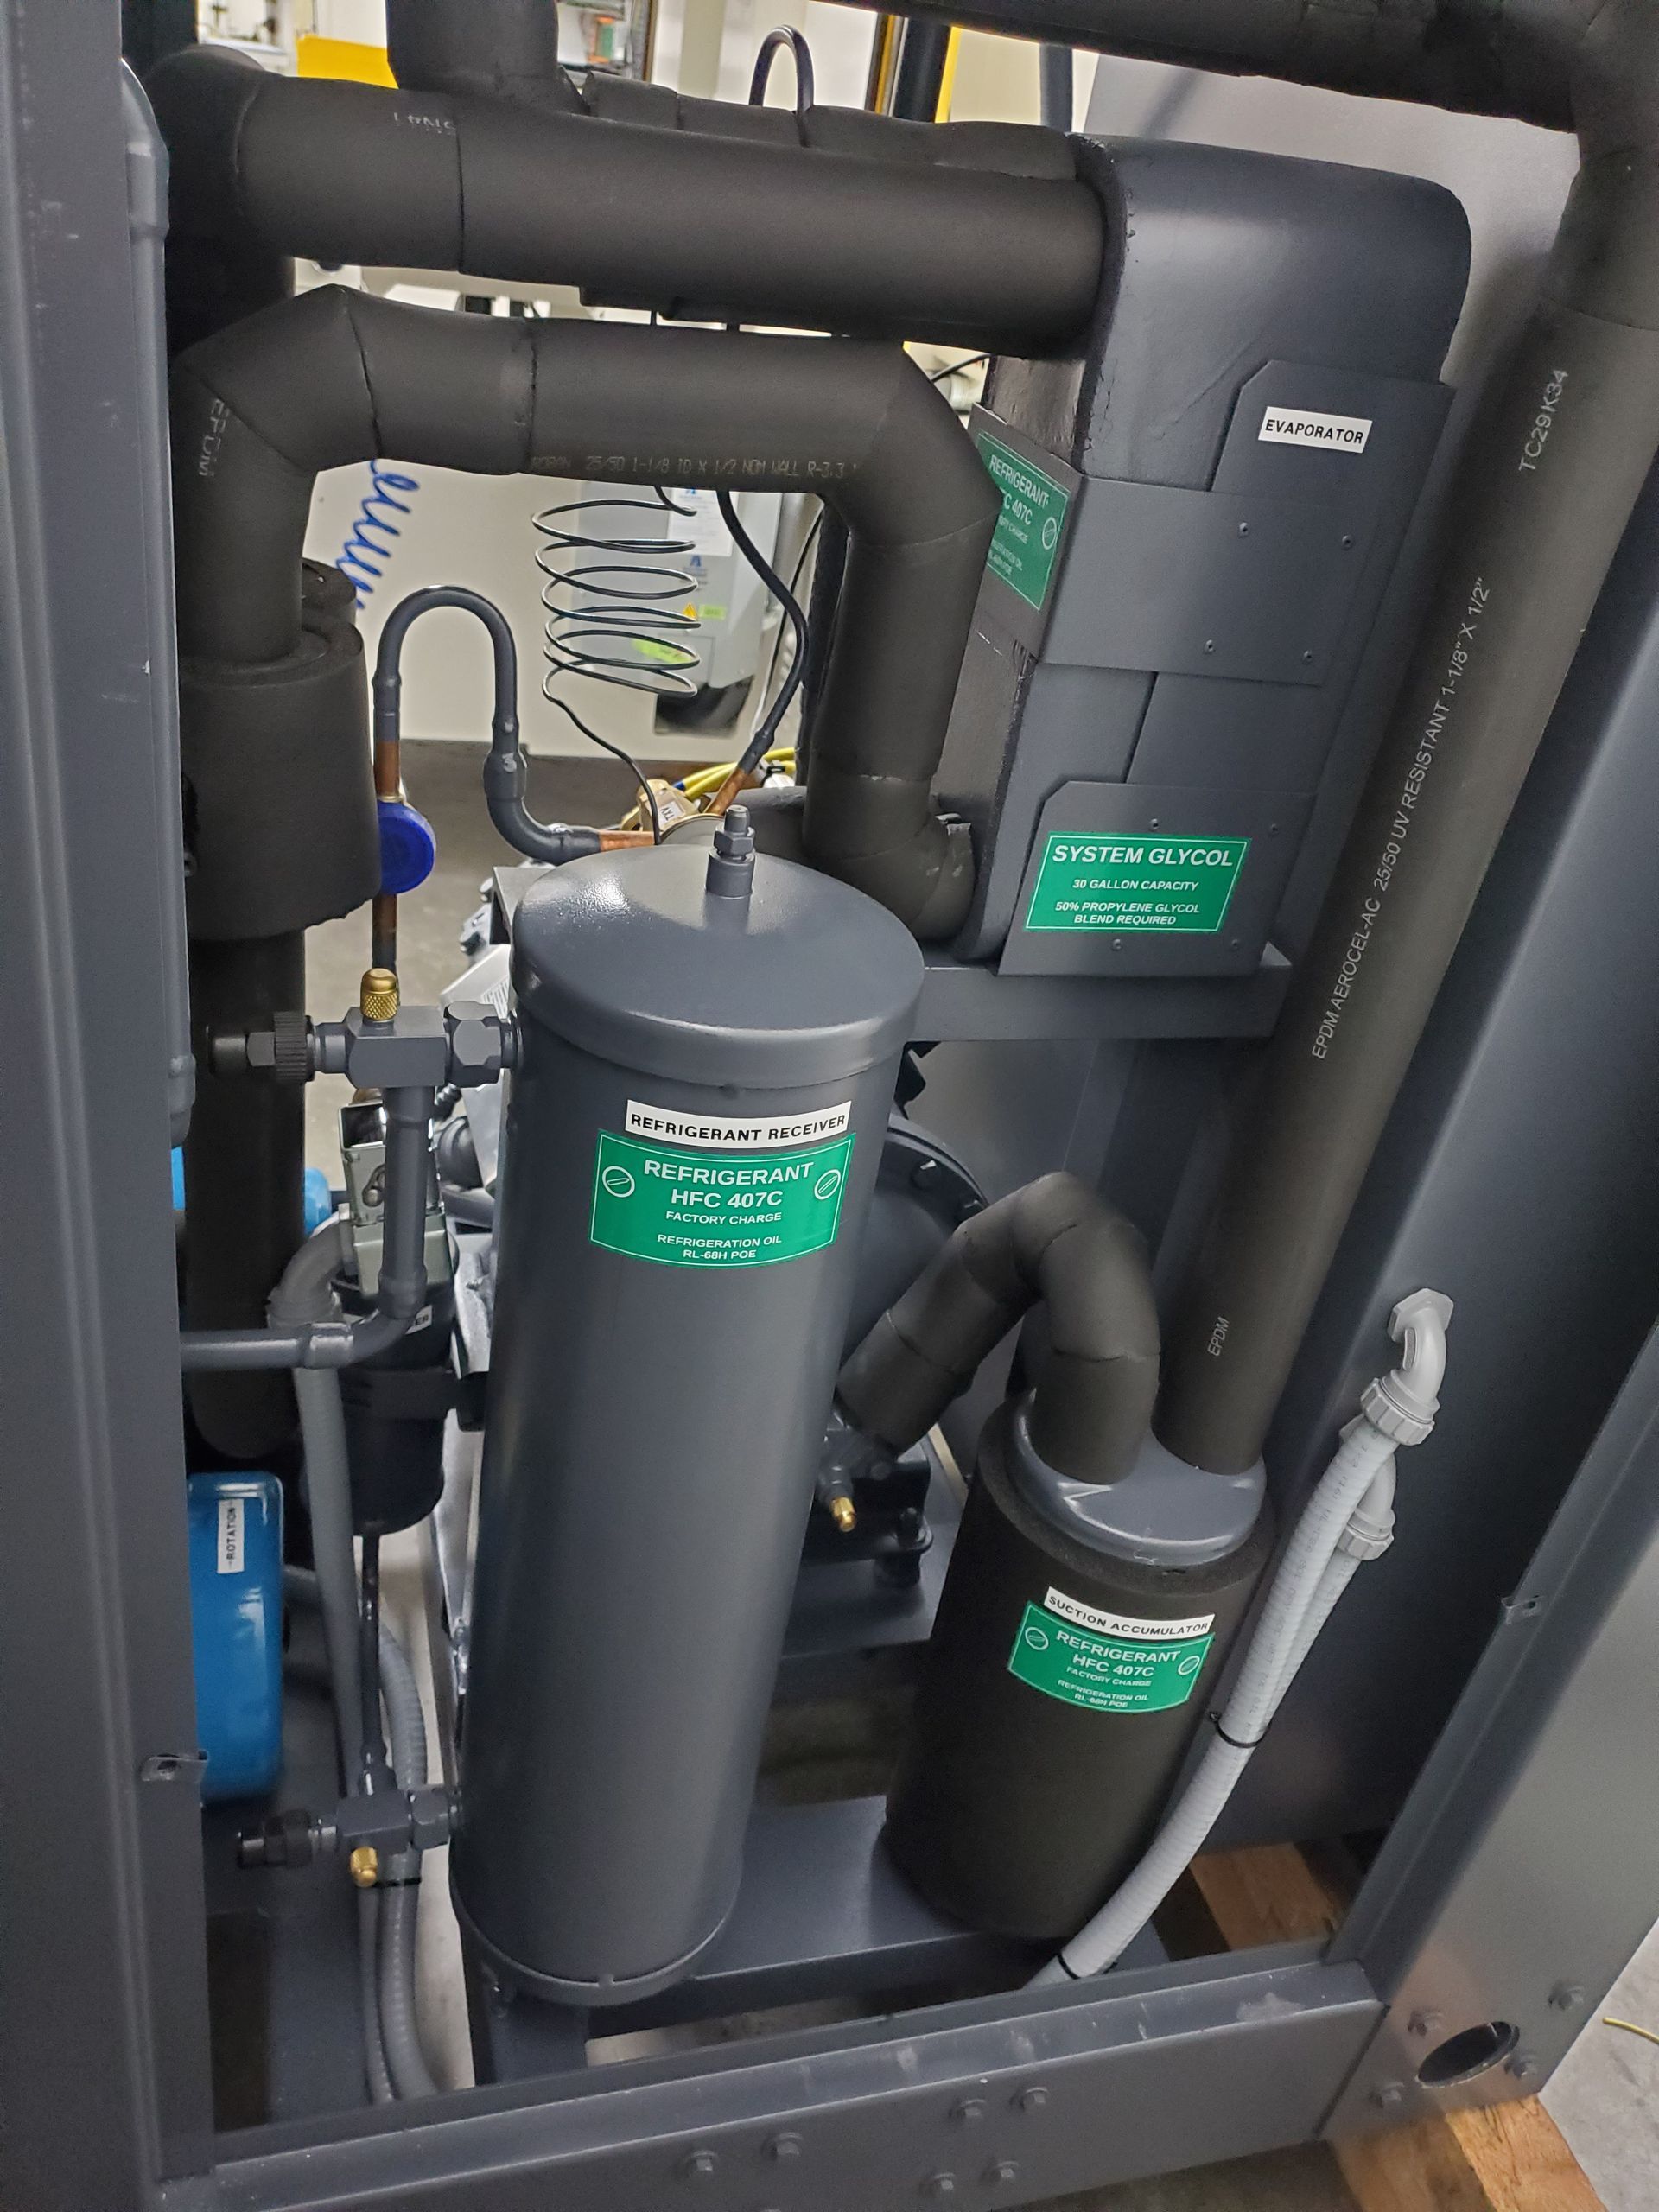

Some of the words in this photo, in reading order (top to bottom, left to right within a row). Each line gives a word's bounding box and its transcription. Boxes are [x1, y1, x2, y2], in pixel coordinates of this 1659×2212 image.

[1265, 419, 1363, 444] EVAPORATOR
[698, 461, 707, 473] X
[988, 454, 1050, 510] REFRIGERANT
[1012, 500, 1033, 525] 407C
[1468, 577, 1490, 615] 1/2"
[1460, 622, 1477, 639] X
[1441, 641, 1468, 695] 1-1/8"
[1401, 699, 1450, 809] RESISTANT
[659, 806, 675, 821] TXV
[1391, 810, 1411, 839] UV
[1052, 845, 1144, 864] SYSTEM
[1148, 848, 1233, 867] GLYCOL
[1373, 842, 1402, 892] 25/50
[1072, 879, 1087, 889] 30
[1089, 880, 1138, 890] GALLON
[1141, 880, 1198, 891] CAPACITY
[1055, 902, 1079, 912] 50%
[1082, 902, 1153, 912] PROPYLENE
[1155, 903, 1199, 913] GLYCOL
[1074, 914, 1114, 924] BLEND
[1116, 916, 1176, 926] REQUIRED
[1331, 898, 1381, 1010] AEROCEL-AC
[1312, 1010, 1339, 1059] EPDM
[631, 1114, 762, 1141] REFRIGERANT
[768, 1115, 846, 1140] RECEIVER
[644, 1160, 815, 1186] REFRIGERANT
[671, 1188, 721, 1208] HFC
[728, 1190, 784, 1208] 407C
[666, 1211, 727, 1224] FACTORY
[729, 1212, 782, 1224] CHARGE
[658, 1234, 760, 1249] REFRIGERATION
[763, 1235, 782, 1244] OIL
[683, 1249, 728, 1261] RL-68H
[730, 1249, 756, 1260] POE
[1208, 1316, 1230, 1356] EPDM
[226, 1508, 237, 1560] ROTATION
[1048, 1596, 1107, 1627] SUCTION
[1110, 1623, 1208, 1636] ACCUMULATOR
[1056, 1630, 1181, 1662] REFRIGERANT
[1066, 1666, 1111, 1684] FACTORY
[1112, 1677, 1152, 1687] CHARGE
[1072, 1654, 1109, 1673] HFC
[1112, 1665, 1155, 1677] 407C
[1058, 1680, 1133, 1701] REFRIGERATION
